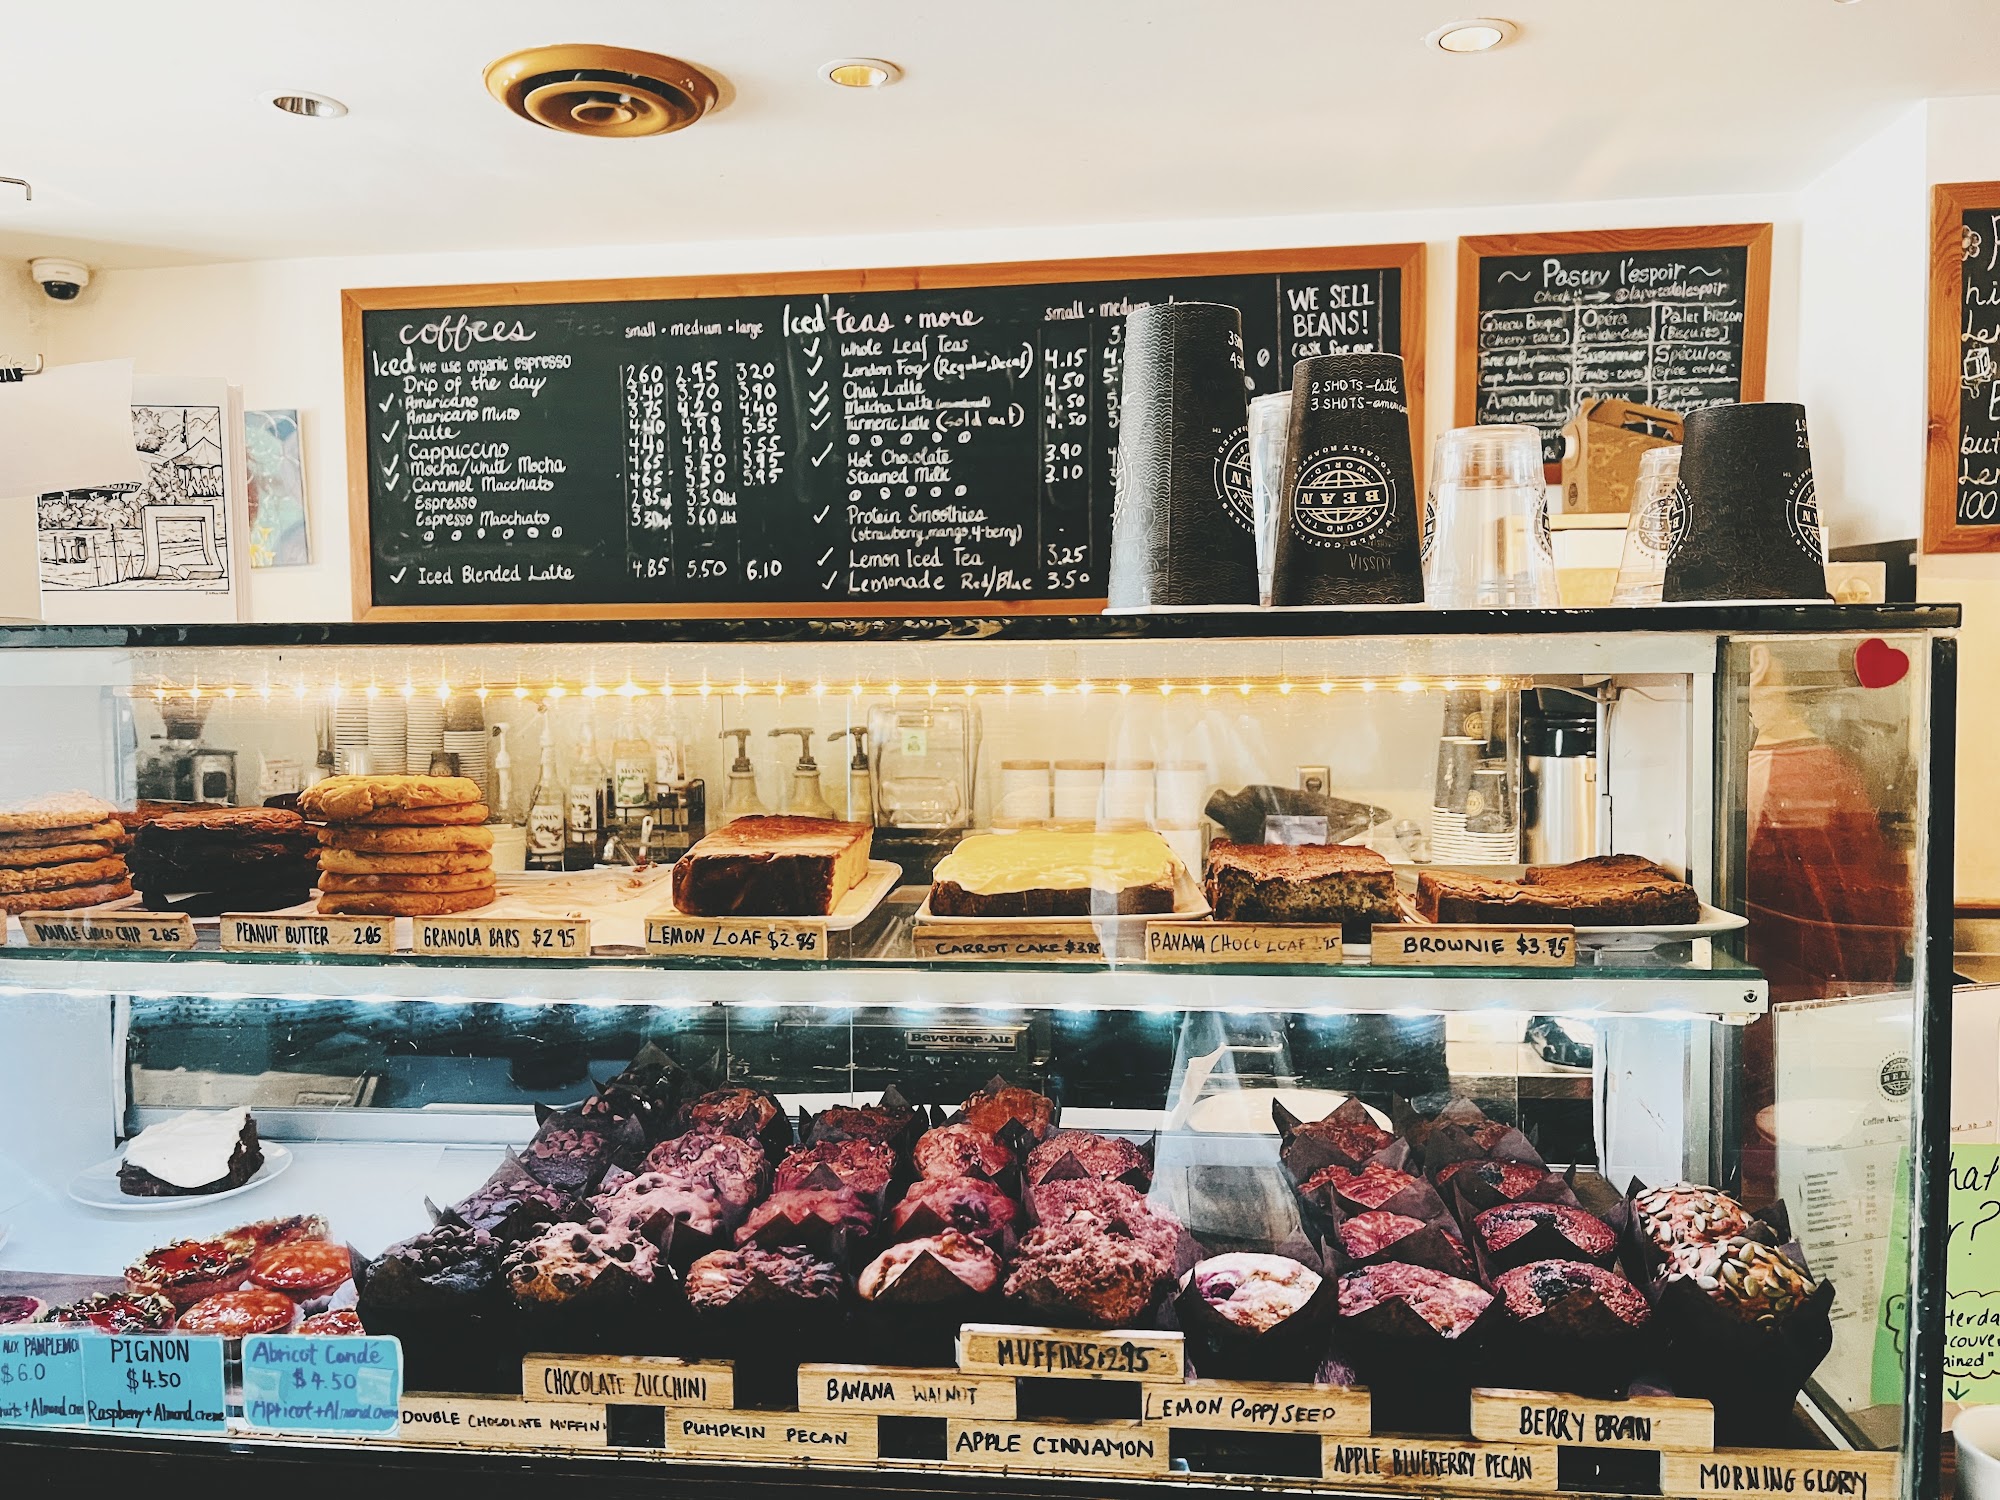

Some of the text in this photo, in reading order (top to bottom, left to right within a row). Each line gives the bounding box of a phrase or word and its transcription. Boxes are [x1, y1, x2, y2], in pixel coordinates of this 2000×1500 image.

[1543, 259, 1610, 287] Pastry
[1287, 283, 1375, 311] WE SELL
[783, 303, 984, 337] Iced teas more
[1044, 300, 1085, 321] small
[399, 314, 536, 352] coffees
[625, 319, 764, 340] small medium large
[1293, 310, 1368, 337] BEANS!
[841, 334, 969, 361] Whole Leaf Teas
[373, 346, 416, 376] Iced
[420, 354, 572, 377] we use organic espresso
[842, 358, 930, 380] London Fog
[1045, 348, 1087, 369] 4.15
[675, 360, 718, 385] 2.95
[403, 374, 546, 398] Drip of the day
[627, 381, 777, 402] 3.40 3.70 3.90
[843, 378, 926, 399] Chai Latte
[1312, 379, 1363, 395] 2 SHOTS
[405, 395, 479, 410] Americano
[628, 399, 778, 419] 3.75 4.20 4.40
[897, 395, 934, 411] Latte
[1045, 394, 1085, 411] 4.50
[1310, 396, 1364, 411] 3 SHOTS
[407, 405, 521, 425] Americano Misto
[681, 415, 721, 435] 4.98
[742, 417, 778, 435] 5.55
[844, 415, 899, 431] Turmeric
[1046, 413, 1087, 430] 4.50
[408, 424, 460, 441] Latte
[409, 441, 509, 463] Cappuccino
[629, 434, 664, 456] 4.40
[1045, 443, 1082, 463] 3.90
[518, 455, 566, 474] Mocha
[685, 451, 785, 471] 5.50 5.95
[847, 447, 953, 468] Hot Chocolate
[743, 468, 783, 486] 5.95
[846, 466, 952, 484] Steamed Milk
[1045, 465, 1083, 483] 3.10
[1315, 462, 1366, 475] WORLD
[412, 474, 554, 493] Caramel Macchiato
[415, 495, 478, 513] Espresso
[1300, 490, 1380, 505] BEAN
[416, 510, 550, 530] Espresso Macchiato
[846, 503, 988, 524] Protein Smoothies
[1300, 509, 1379, 532] AROUND THE
[849, 546, 984, 568] Lemon Iced Tea
[1047, 543, 1087, 565] 3.25
[418, 564, 575, 585] Iced Blended Latte
[632, 557, 783, 581] 4.85 5.50 6.10
[1047, 569, 1090, 590] 3.50
[848, 569, 945, 594] Lemonade
[34, 924, 141, 942] DOUBLE CHIP
[236, 922, 329, 945] PEANUT BUTTER
[424, 926, 520, 948] GRANOLA BARS
[648, 923, 817, 951] LEMON LOAF $2.95
[1151, 932, 1205, 953] BANANA
[936, 943, 1008, 955] CARROT
[1015, 943, 1062, 954] CAKE
[1404, 933, 1569, 957] BROWNIE $3.75
[111, 1339, 190, 1363] PIGNON
[252, 1341, 318, 1366] Abricot
[127, 1368, 182, 1394] $4.50
[293, 1368, 357, 1391] $4.50
[545, 1367, 706, 1402] CHOCOLATE ZUCCHINI
[826, 1378, 977, 1405] BANANA WALNUT
[1145, 1393, 1222, 1420] LEMON
[402, 1410, 460, 1425] DOUBLE
[468, 1414, 542, 1428] CHOCOLATE
[1520, 1406, 1651, 1442] BERRY BRAN
[683, 1420, 847, 1445] PUMPKIN PECAN
[956, 1431, 1154, 1458] APPLE CINNAMON
[1334, 1444, 1532, 1480] APPLE BLUEBERRY PECAN
[1700, 1463, 1867, 1500] MORNING GLORY
